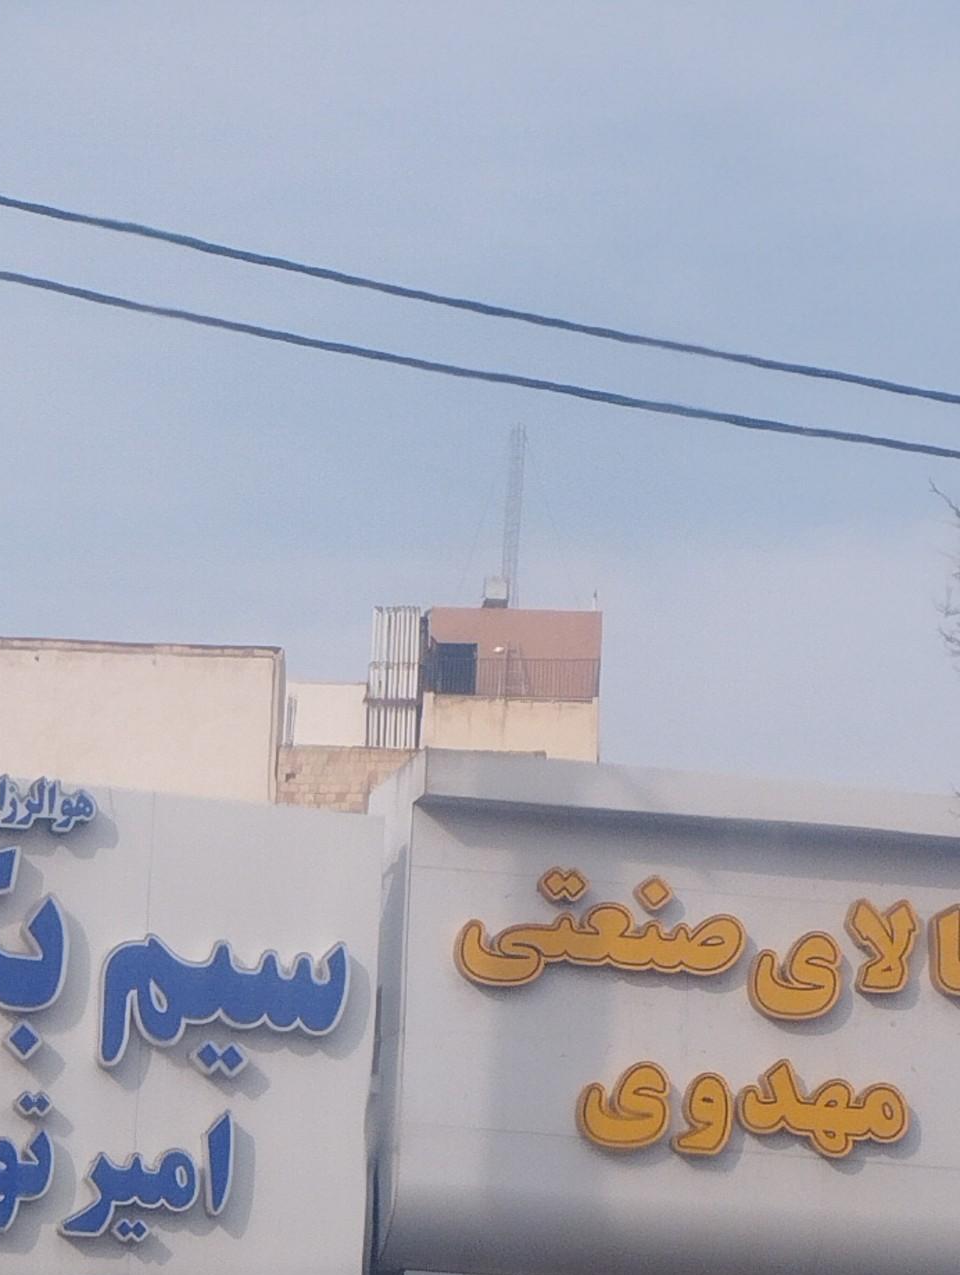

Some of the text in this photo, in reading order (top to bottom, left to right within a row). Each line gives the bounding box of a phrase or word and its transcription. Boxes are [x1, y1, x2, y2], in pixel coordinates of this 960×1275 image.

[100, 936, 348, 1076] سیم
[455, 866, 960, 1020] الای صنعتی
[58, 1109, 235, 1239] امیر
[577, 1059, 911, 1158] مهدوی
